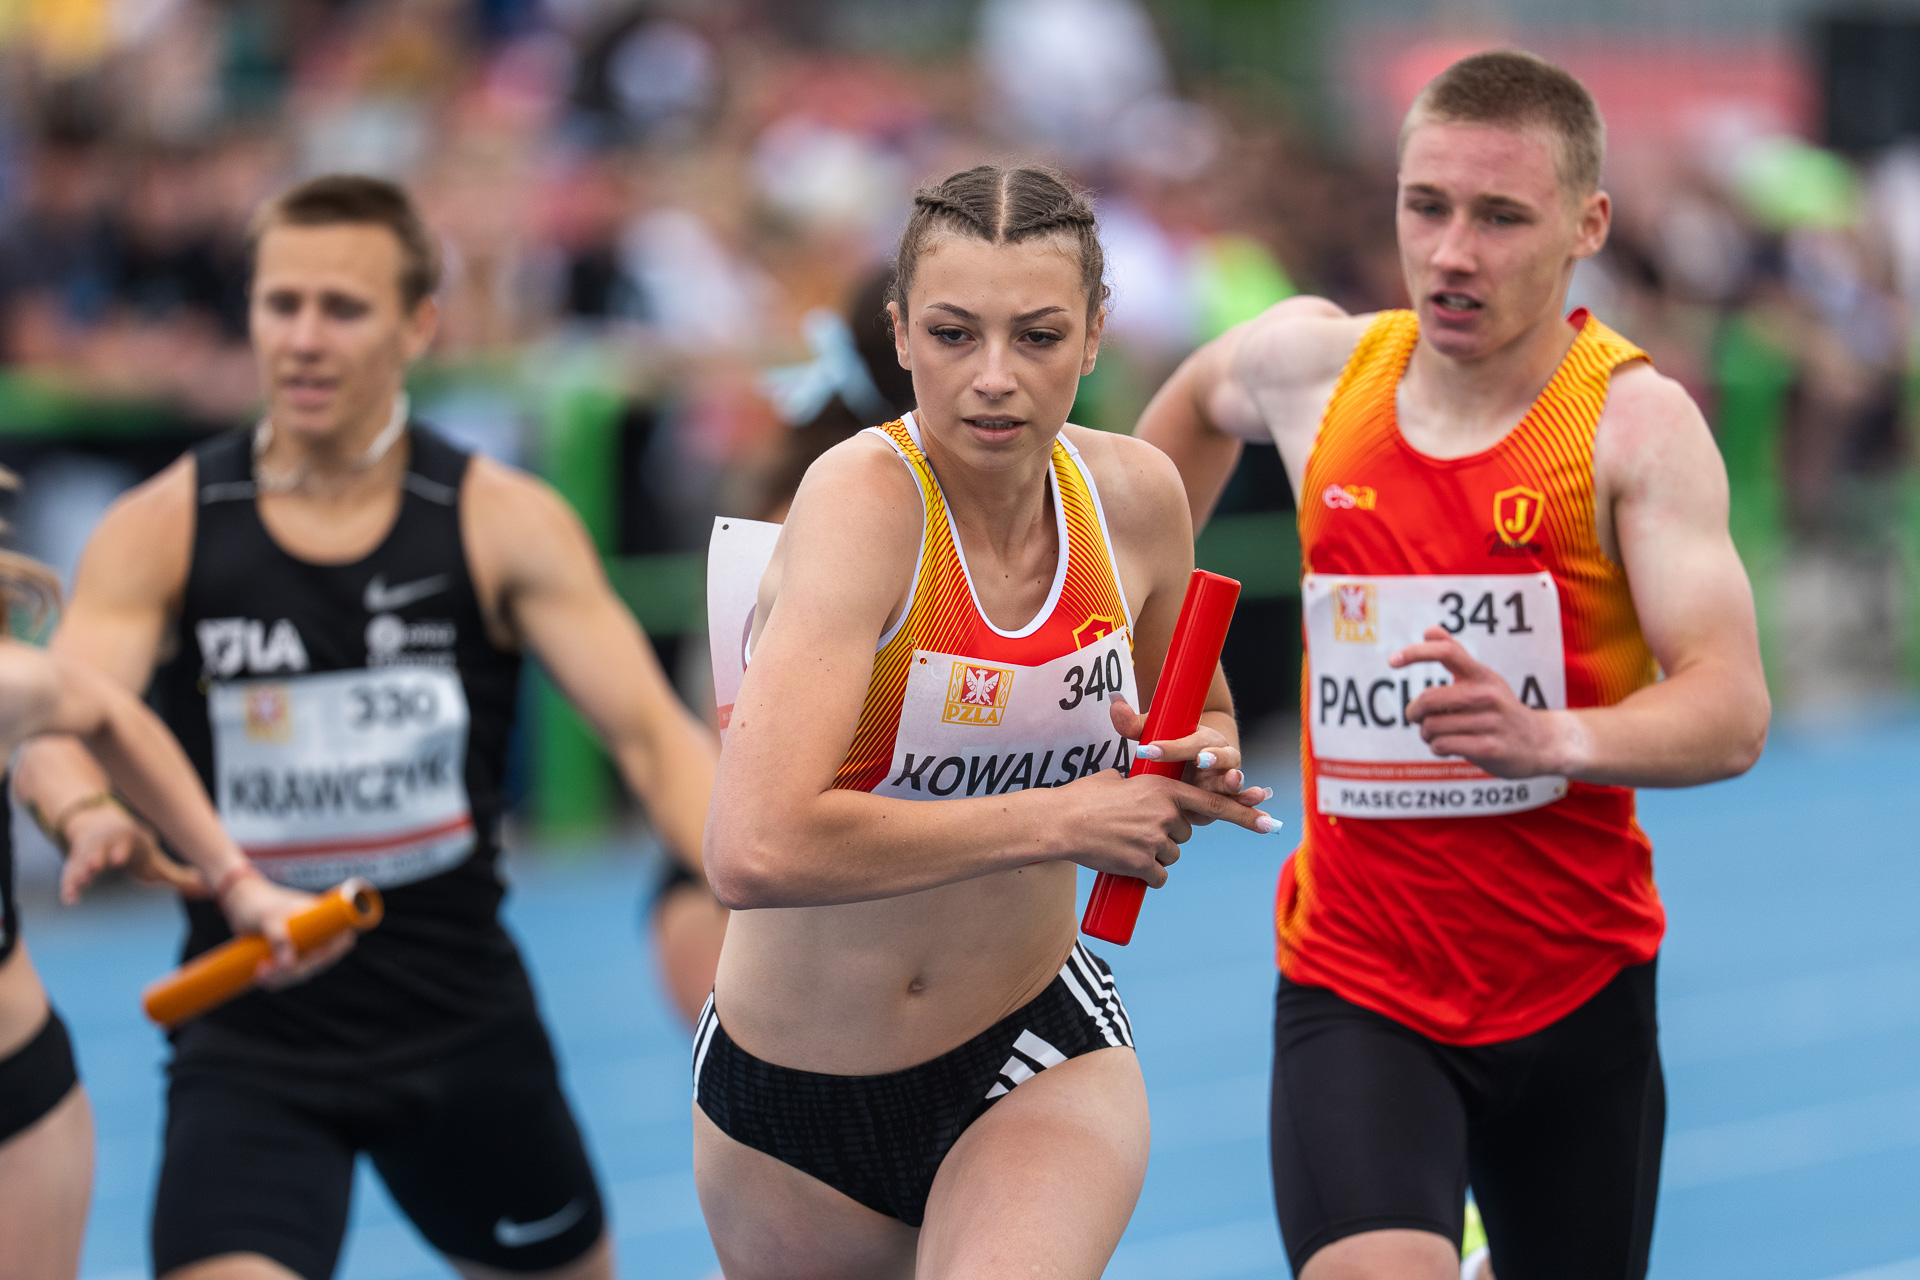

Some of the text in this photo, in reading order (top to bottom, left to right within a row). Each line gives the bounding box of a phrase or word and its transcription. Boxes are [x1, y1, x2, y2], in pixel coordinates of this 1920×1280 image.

[1322, 484, 1377, 510] esa
[1505, 498, 1529, 533] J
[1438, 590, 1533, 635] 341
[1058, 648, 1122, 711] 340
[351, 683, 439, 732] 330
[945, 703, 998, 723] PZLA
[891, 736, 1130, 797] KOWALSKA
[1340, 783, 1530, 808] PIASECZNO 2026
